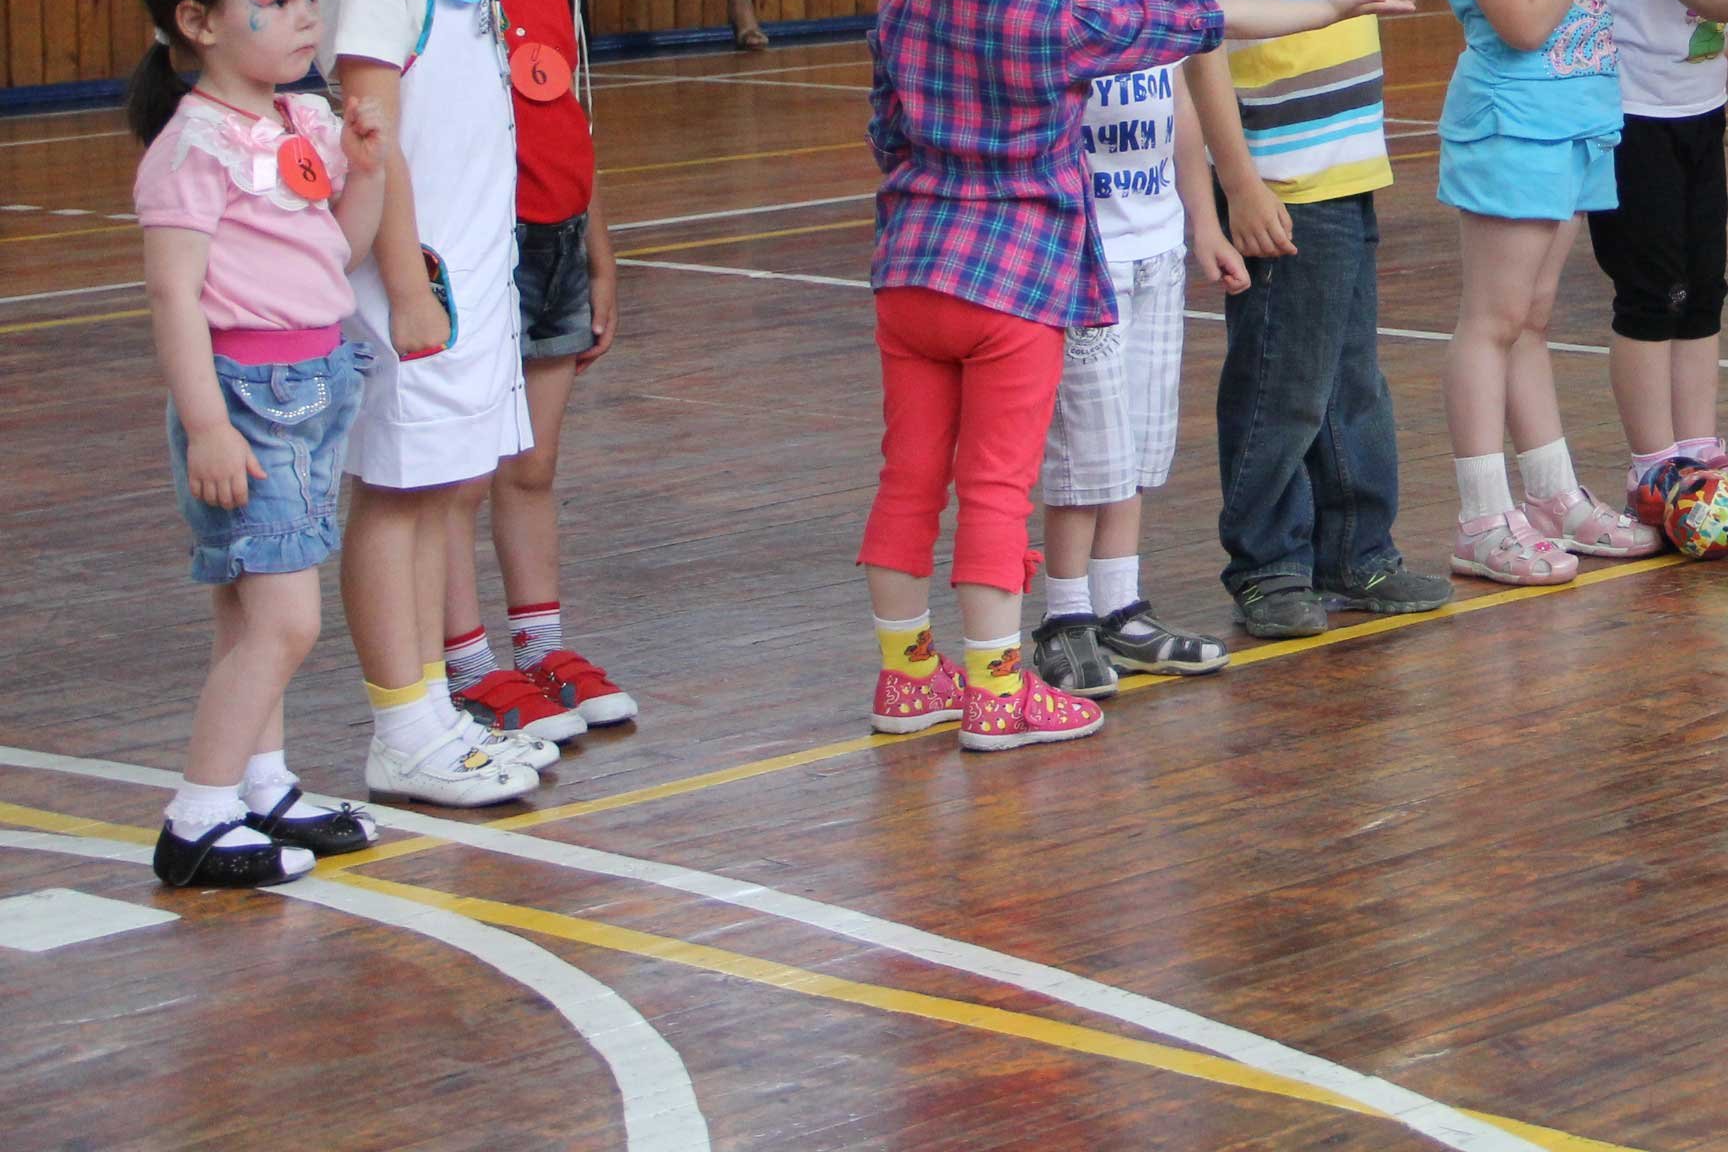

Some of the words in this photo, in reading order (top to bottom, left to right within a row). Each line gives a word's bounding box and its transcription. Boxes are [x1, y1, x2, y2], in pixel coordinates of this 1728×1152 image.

[532, 62, 547, 86] 6
[1088, 67, 1172, 107] УТБОЛ
[1079, 119, 1156, 154] АЧКИ
[298, 157, 317, 183] 8
[1092, 156, 1171, 199] ВЧОНК
